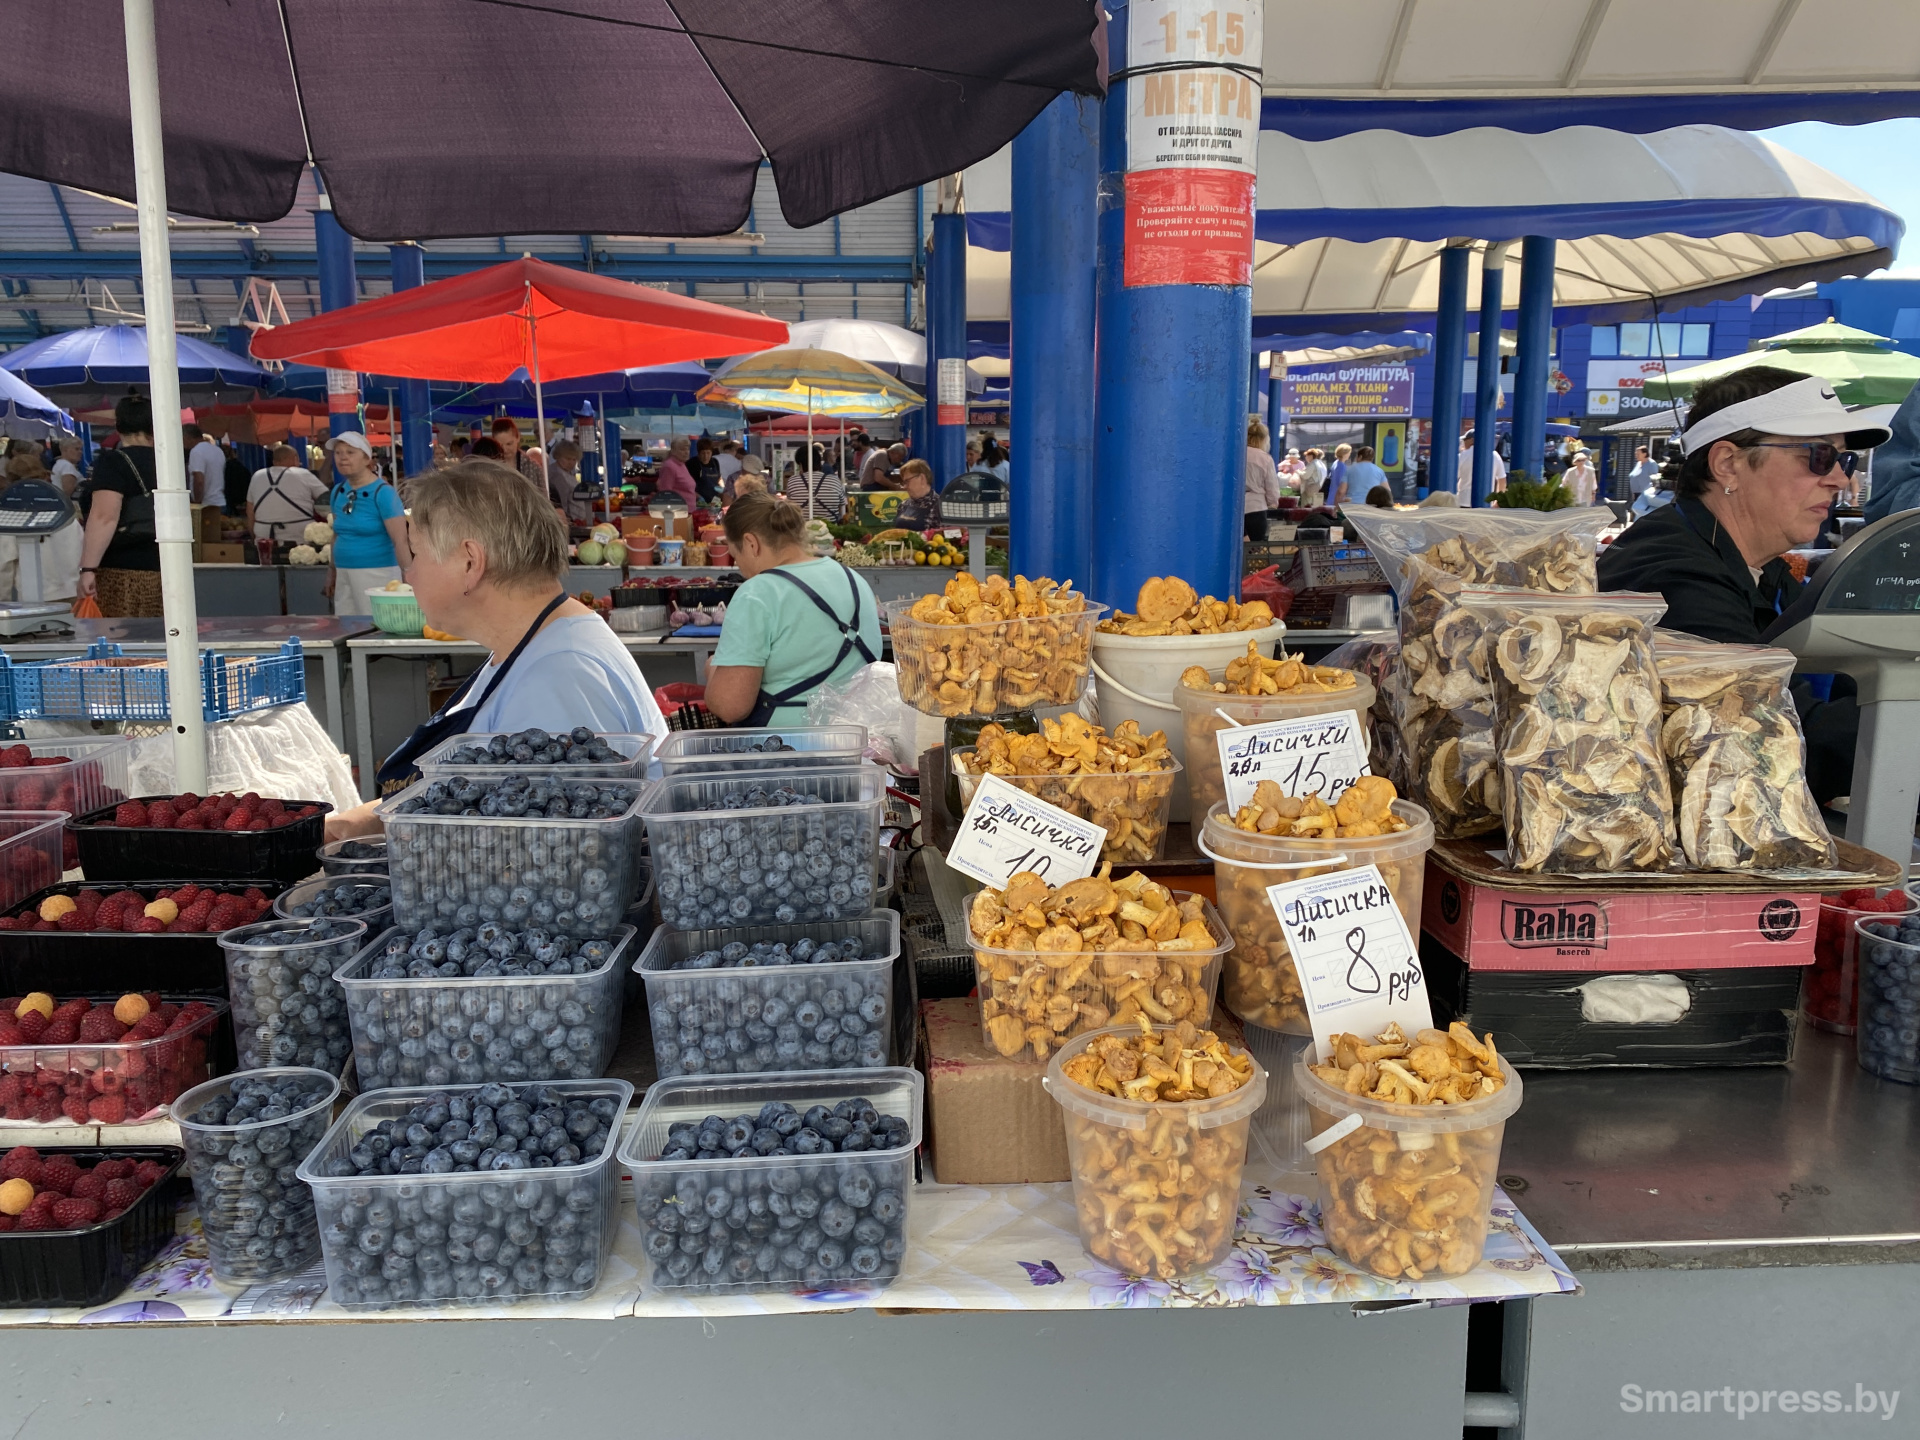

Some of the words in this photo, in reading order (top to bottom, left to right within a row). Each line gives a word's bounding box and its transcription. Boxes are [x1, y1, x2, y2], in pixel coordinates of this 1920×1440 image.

[1144, 73, 1253, 120] МЕТРА
[1158, 126, 1168, 137] ОТ
[1214, 127, 1242, 139] КАССИРА
[1173, 140, 1178, 148] И
[1179, 138, 1198, 149] ДРУГ
[1200, 139, 1209, 148] ОТ
[1211, 139, 1232, 149] ДРУГА
[1156, 153, 1184, 163] БЕРЕГИТЕ
[1185, 153, 1200, 161] СЕБЯ
[1141, 204, 1196, 215] Уважаемые
[1137, 216, 1193, 229] Проверяйте
[1196, 217, 1220, 226] сдачу
[1144, 231, 1155, 239] не
[1157, 228, 1189, 238] отходя
[1191, 229, 1202, 237] от
[1339, 367, 1410, 381] ФУРНИТУРА
[1296, 383, 1329, 394] КОЖА,
[1330, 383, 1352, 393] МЕХ,
[1355, 383, 1389, 393] ТКАНИ
[1301, 395, 1342, 405] РЕМОНТ,
[1345, 395, 1382, 405] ПОШИВ
[1302, 406, 1338, 414] ДУБЛЕНОК
[1236, 727, 1350, 758] Лисички
[1283, 752, 1331, 798] 15
[989, 803, 1095, 857] Лисички
[1512, 906, 1597, 941] Raha
[1298, 925, 1316, 942] 1л
[1556, 948, 1590, 956] Basereh
[1345, 926, 1381, 994] 8
[1388, 956, 1422, 1005] руб
